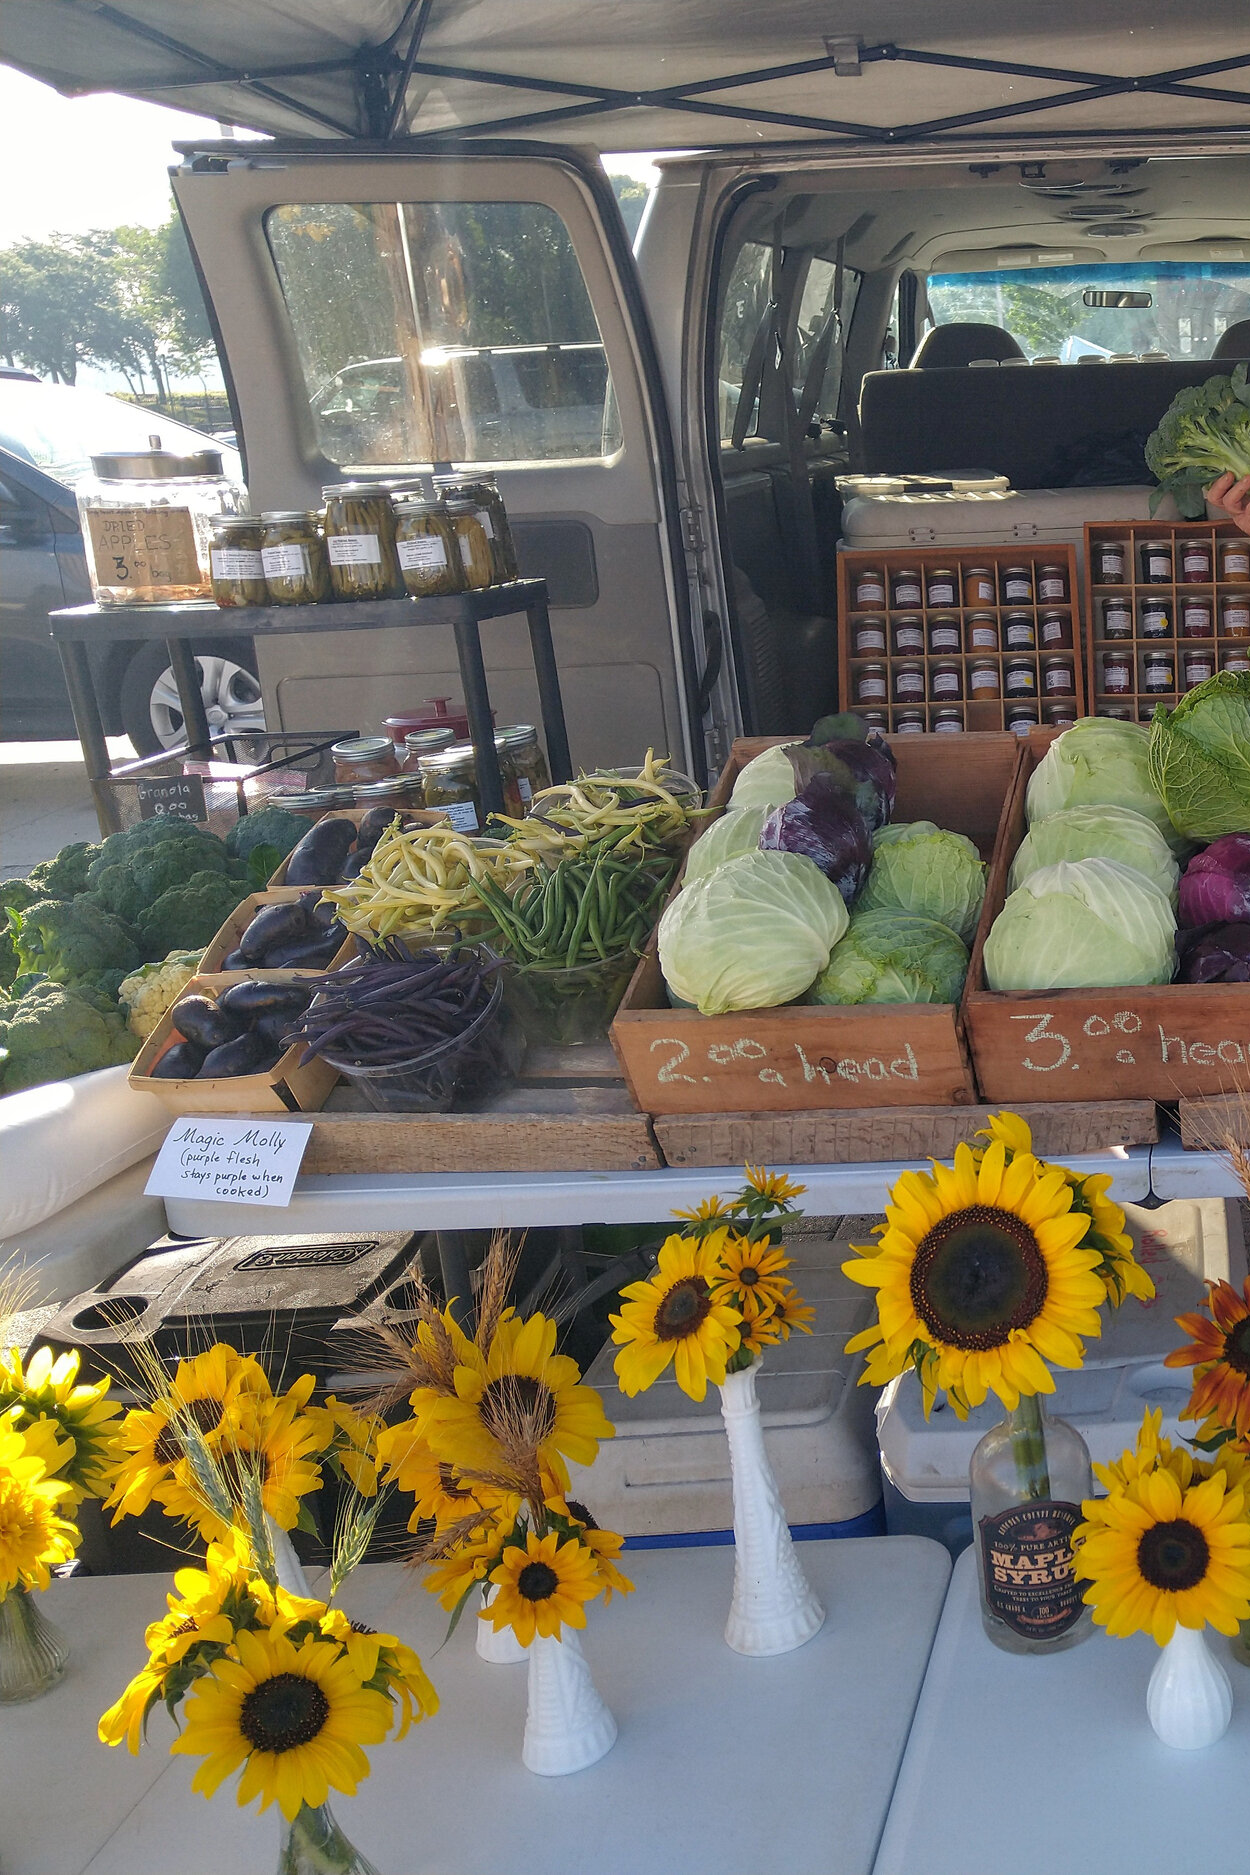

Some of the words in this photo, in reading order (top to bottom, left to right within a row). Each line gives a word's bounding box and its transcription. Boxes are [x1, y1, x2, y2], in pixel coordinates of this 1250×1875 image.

[103, 520, 145, 532] DRIED
[138, 782, 190, 799] Granola
[759, 1068, 788, 1087] a
[795, 1042, 919, 1085] head
[1116, 1050, 1136, 1064] a
[173, 1128, 225, 1152] Magic
[233, 1130, 287, 1155] Molly
[181, 1148, 220, 1166] (purple
[226, 1151, 260, 1167] flesh
[181, 1170, 211, 1184] stays
[214, 1170, 247, 1186] purple
[252, 1169, 283, 1183] when
[216, 1186, 269, 1198] cooked)
[275, 1247, 355, 1261] Coleman
[994, 1541, 1017, 1551] 100%
[1021, 1543, 1045, 1551] PURE
[994, 1562, 1076, 1585] SYRU
